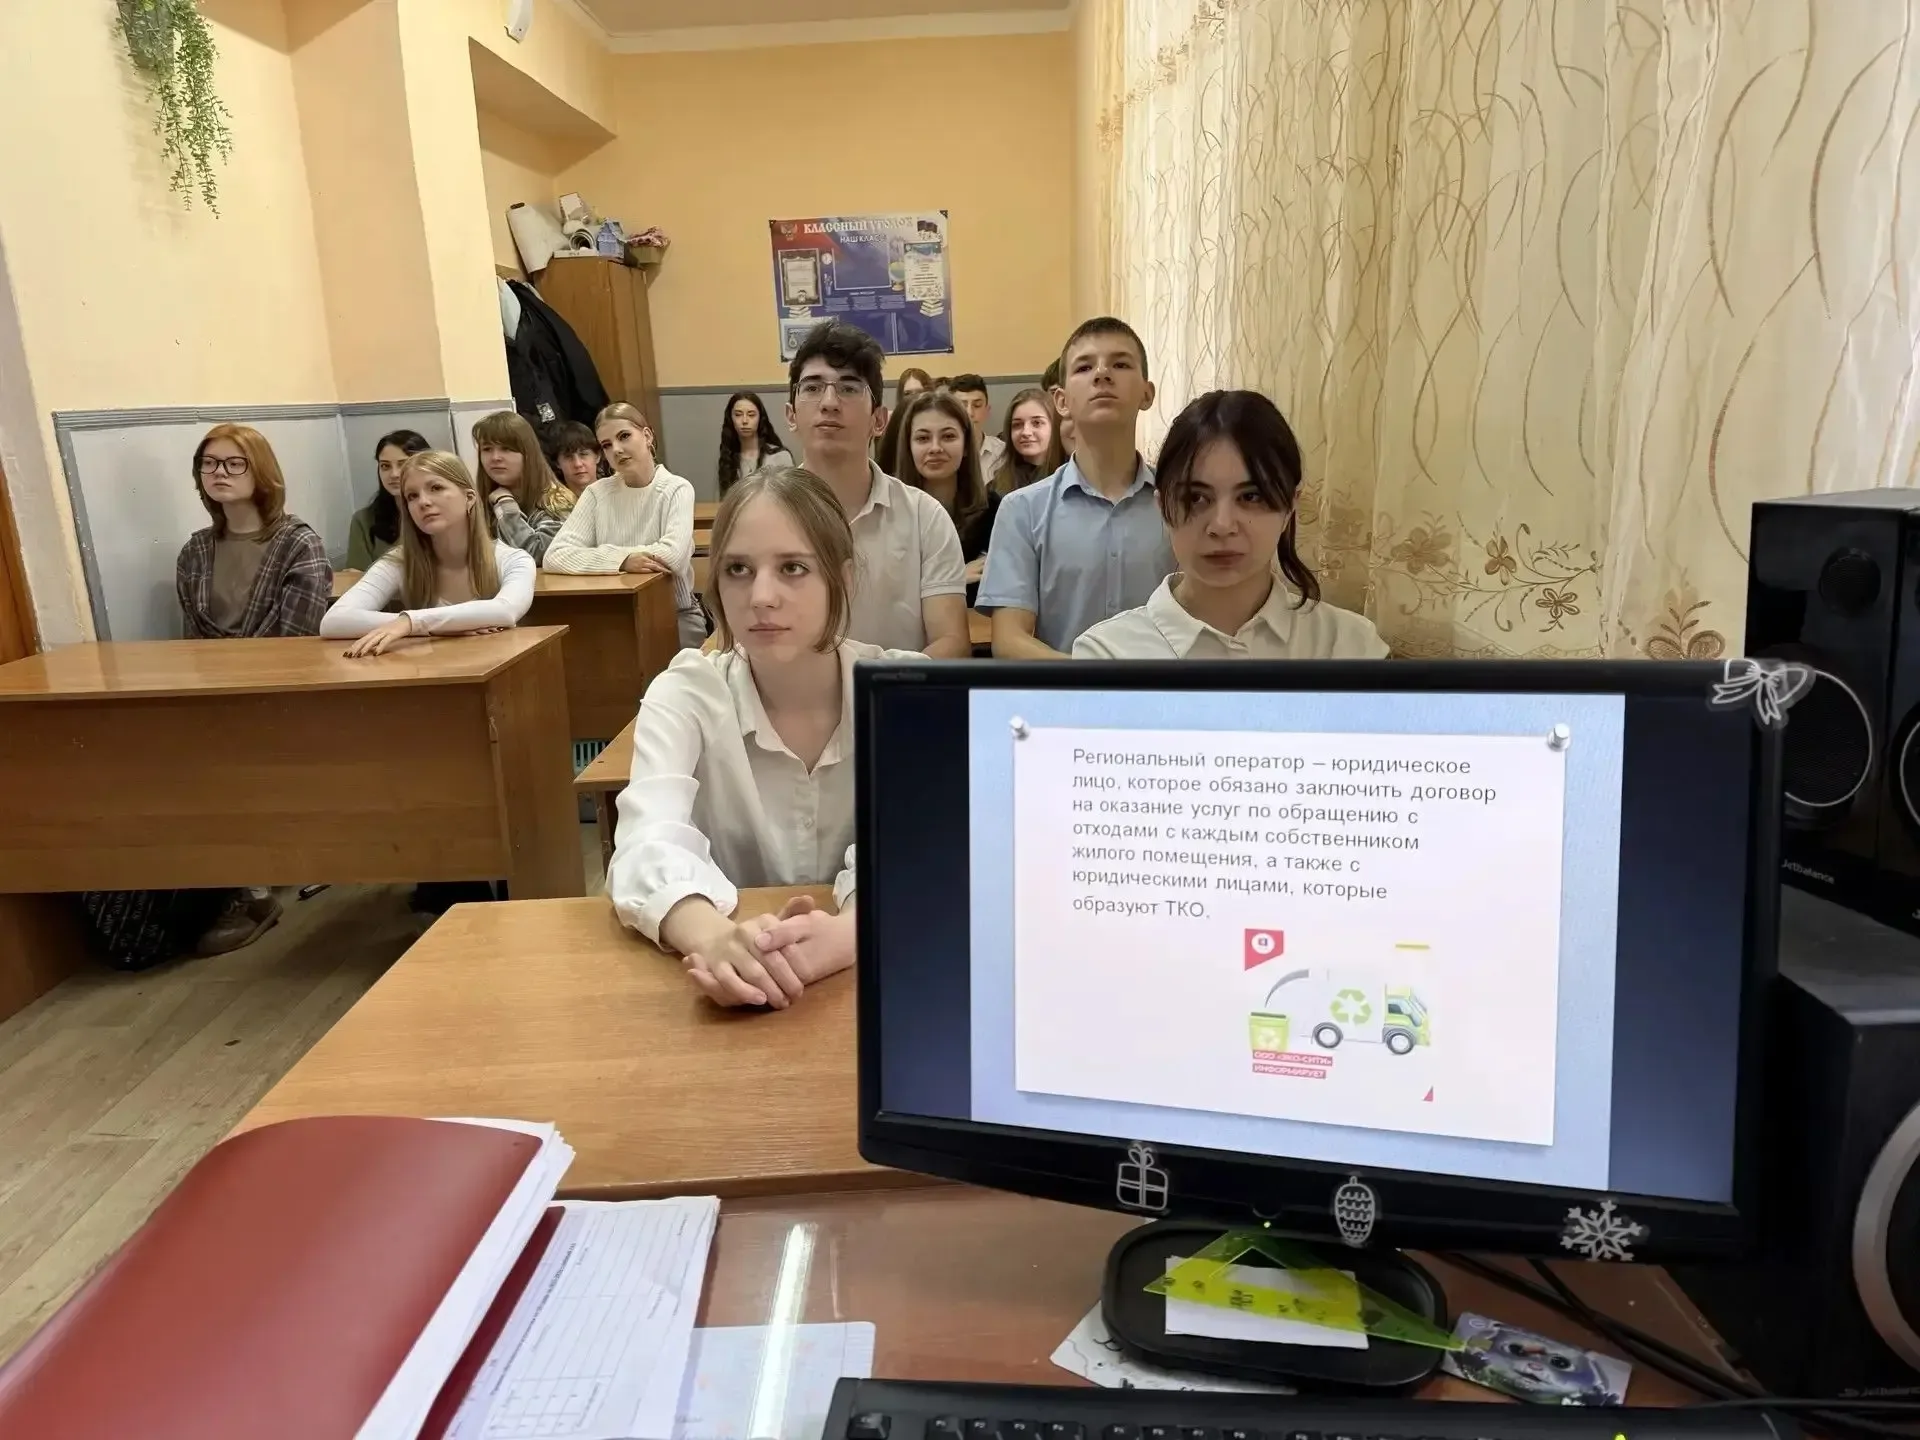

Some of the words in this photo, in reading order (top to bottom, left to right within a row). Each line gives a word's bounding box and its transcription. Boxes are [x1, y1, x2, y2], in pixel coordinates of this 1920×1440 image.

[1073, 748, 1206, 768] Региональный
[1213, 755, 1305, 774] оператор
[1331, 758, 1471, 776] юридическое
[1072, 775, 1121, 792] лицо,
[1127, 776, 1202, 794] которое
[1208, 775, 1288, 794] обязано
[1295, 782, 1403, 799] заключить
[1410, 785, 1497, 806] договор
[1072, 799, 1093, 812] на
[1099, 800, 1183, 815] оказание
[1190, 803, 1241, 821] услуг
[1248, 805, 1271, 818] по
[1278, 803, 1399, 826] обращению
[1407, 811, 1419, 825] с
[1072, 823, 1158, 840] отходами
[1165, 827, 1176, 839] с
[1181, 827, 1259, 845] каждым
[1265, 827, 1419, 850] собственником
[1072, 846, 1136, 861] жилого
[1142, 849, 1258, 869] помещения,
[1266, 855, 1278, 868] а
[1283, 856, 1342, 872] также
[1349, 859, 1361, 873] с
[1072, 870, 1207, 889] юридическими
[1215, 877, 1294, 896] лицами,
[1303, 882, 1388, 902] которые
[1072, 895, 1159, 917] образуют
[1164, 899, 1210, 919] ТКО.
